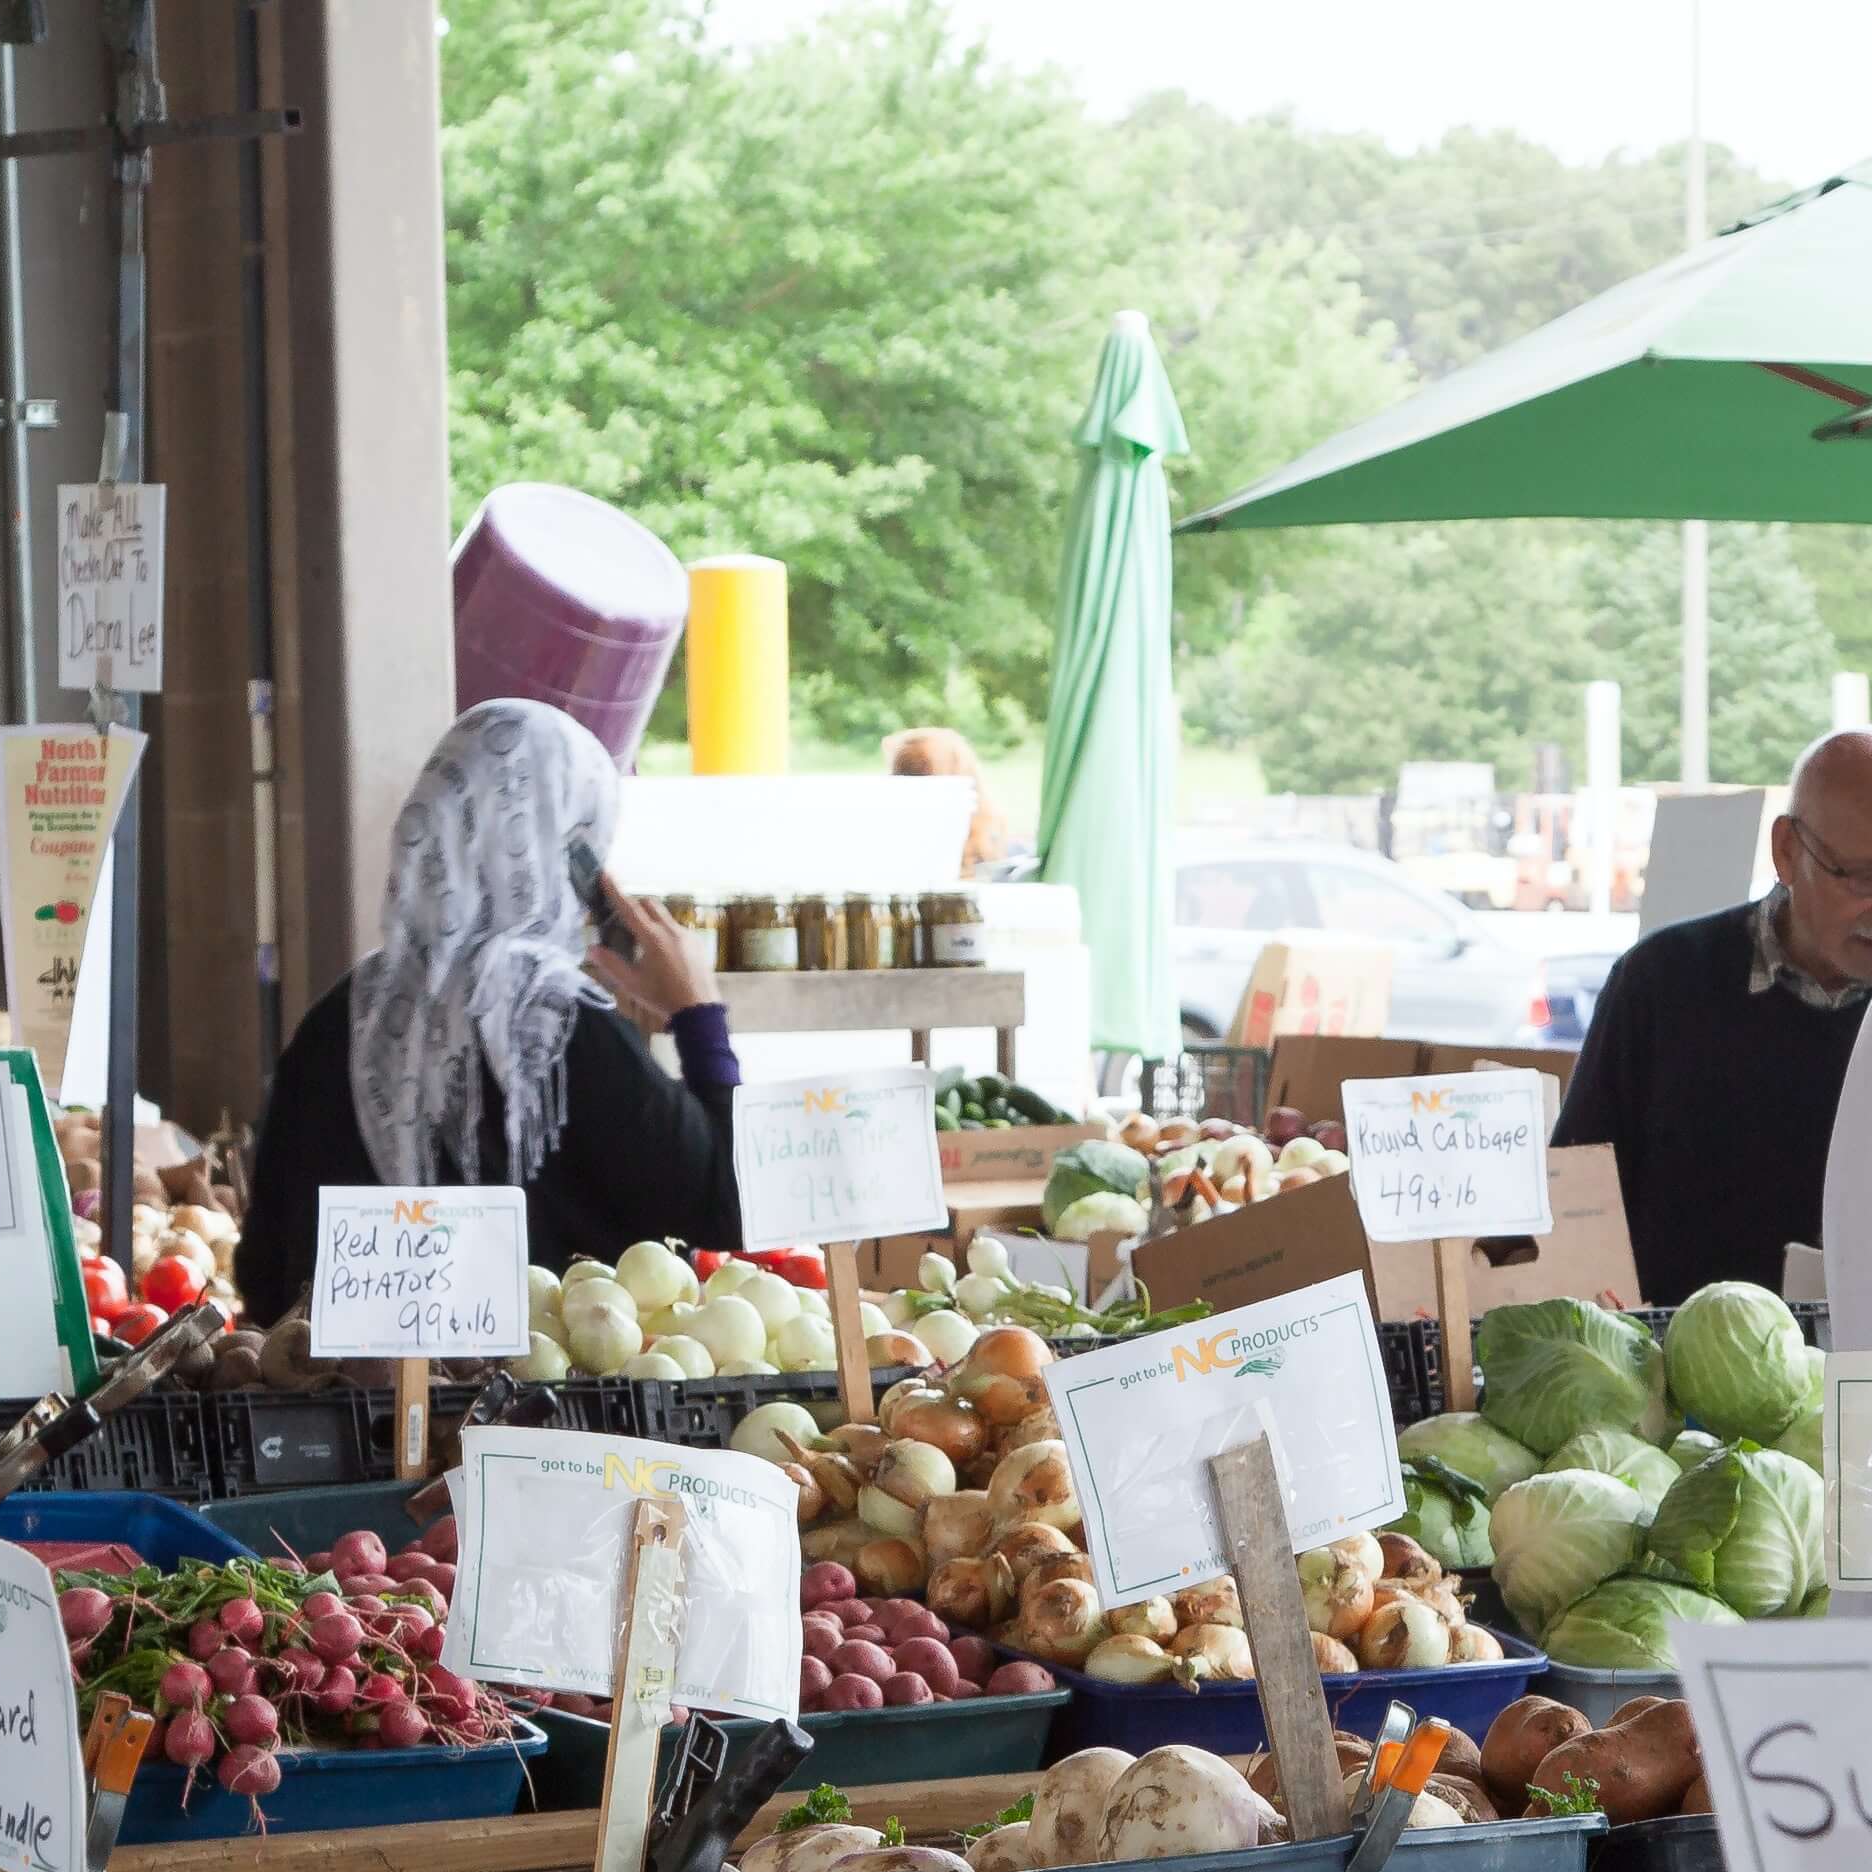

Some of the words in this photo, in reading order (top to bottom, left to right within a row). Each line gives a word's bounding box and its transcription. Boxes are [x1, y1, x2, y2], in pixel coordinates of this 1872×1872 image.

[41, 739, 97, 759] North
[1358, 1114, 1424, 1158] Round
[1431, 1120, 1529, 1155] Cabbage
[332, 1218, 380, 1265] Red
[1118, 1371, 1143, 1391] got
[1143, 1366, 1158, 1380] to
[1158, 1361, 1175, 1376] be
[1170, 1328, 1245, 1383] NC
[1230, 1314, 1320, 1358] PRODUCTS
[540, 1459, 566, 1476] got
[566, 1459, 584, 1474] to
[585, 1460, 604, 1476] be
[603, 1452, 683, 1498] NC
[667, 1472, 759, 1510] PRODUCTS
